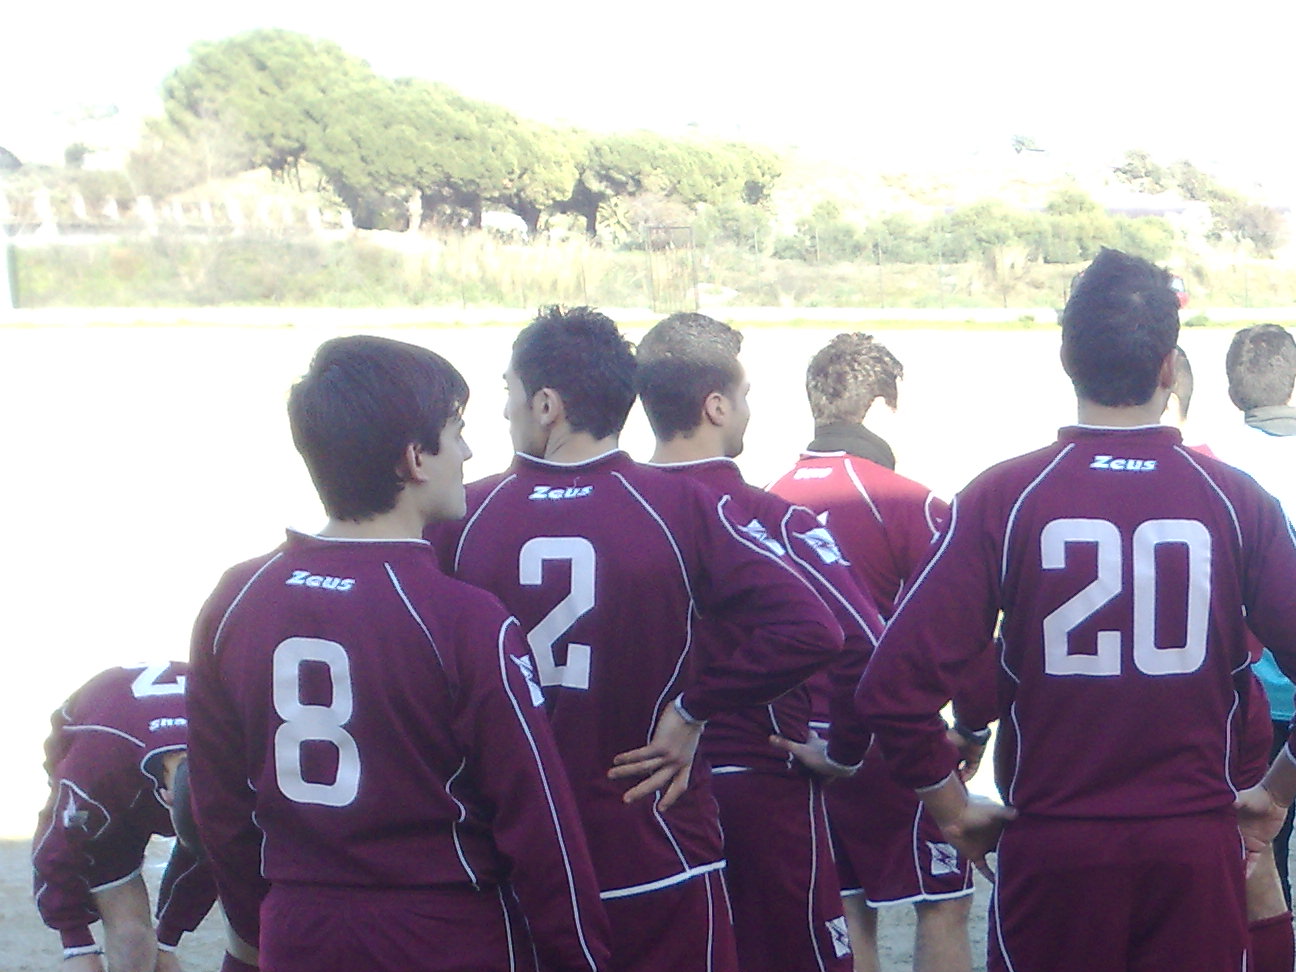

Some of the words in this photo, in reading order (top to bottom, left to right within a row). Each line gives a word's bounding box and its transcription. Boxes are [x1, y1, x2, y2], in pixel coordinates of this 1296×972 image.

[528, 485, 595, 500] Zeus
[1090, 455, 1157, 471] Zeus
[285, 570, 356, 591] Zeus
[519, 537, 595, 689] 2
[1040, 518, 1211, 676] 20
[273, 637, 361, 805] 8
